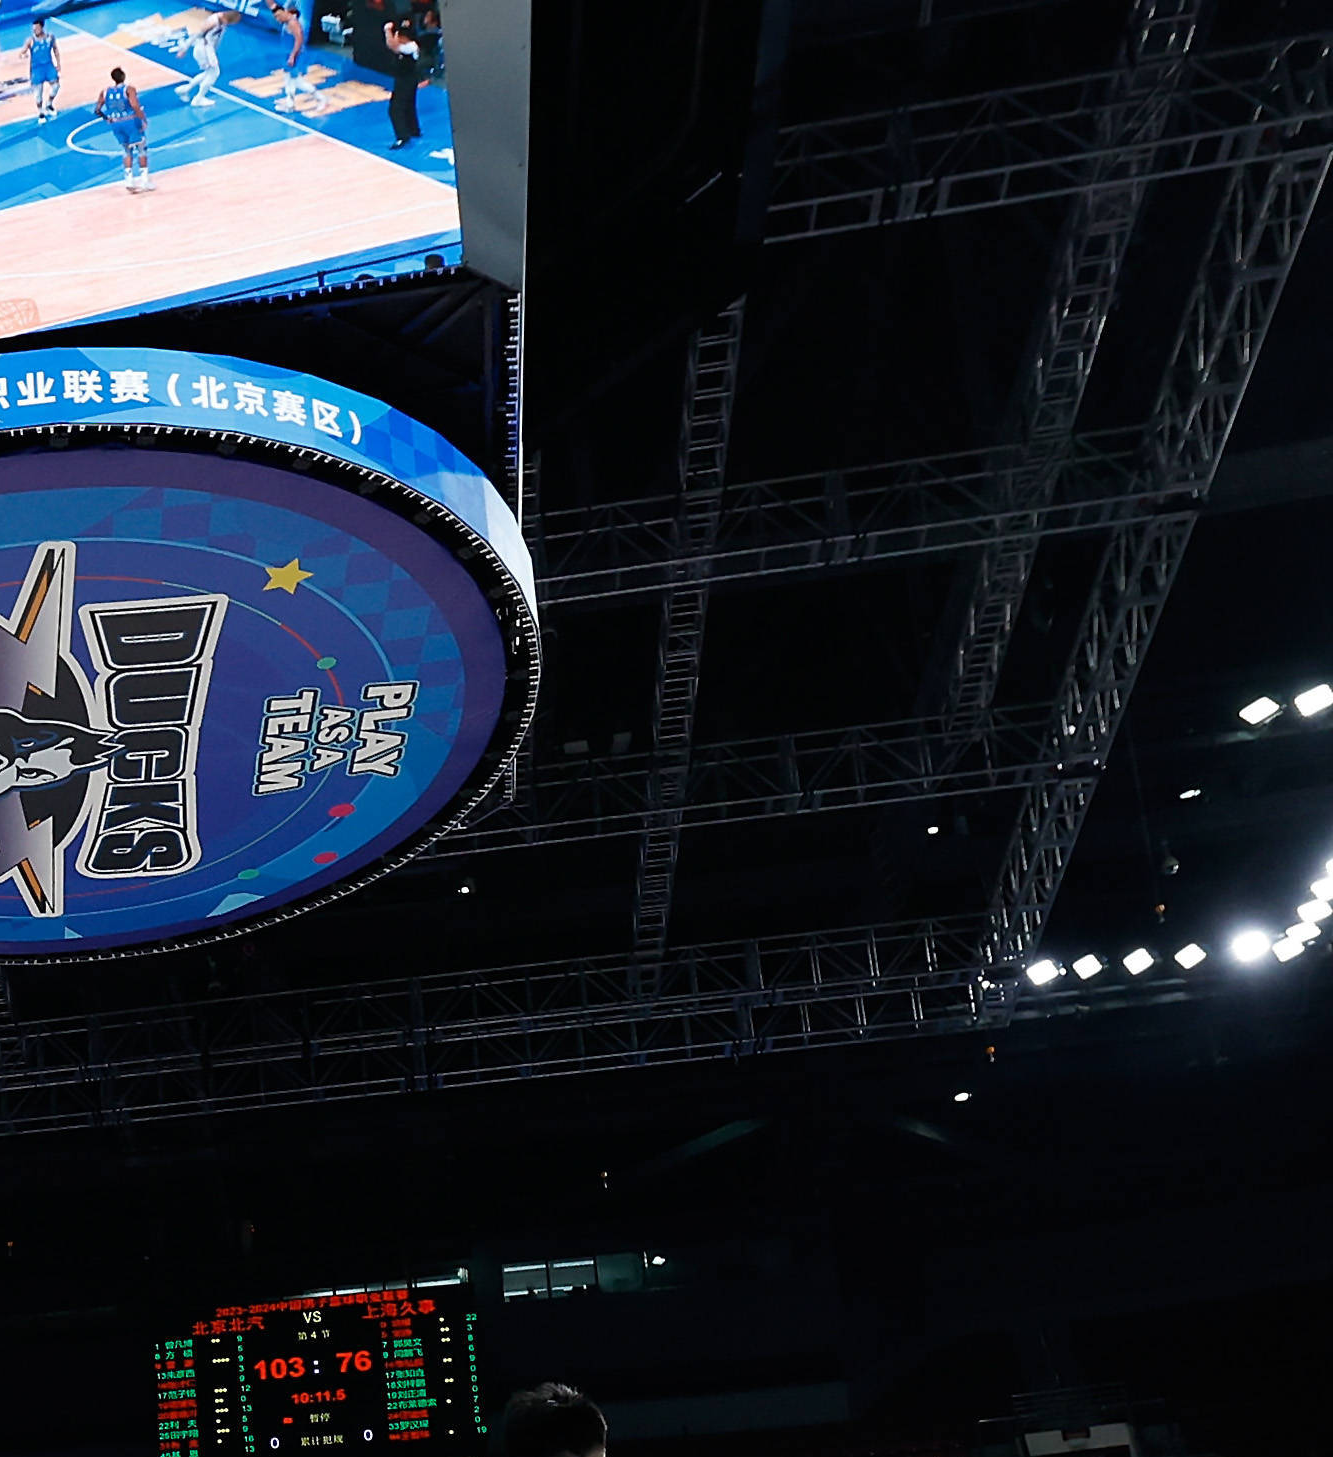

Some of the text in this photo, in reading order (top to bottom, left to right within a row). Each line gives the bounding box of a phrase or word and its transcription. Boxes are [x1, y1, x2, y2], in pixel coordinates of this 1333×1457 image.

[85, 600, 221, 874] DUCKS
[253, 687, 320, 796] TEAM
[308, 706, 357, 774] AS A
[346, 681, 419, 777] PLAY
[303, 1311, 322, 1323] VS
[254, 1357, 305, 1380] 103
[336, 1350, 372, 1373] 76
[270, 1437, 280, 1449] 0
[363, 1429, 373, 1441] 0
